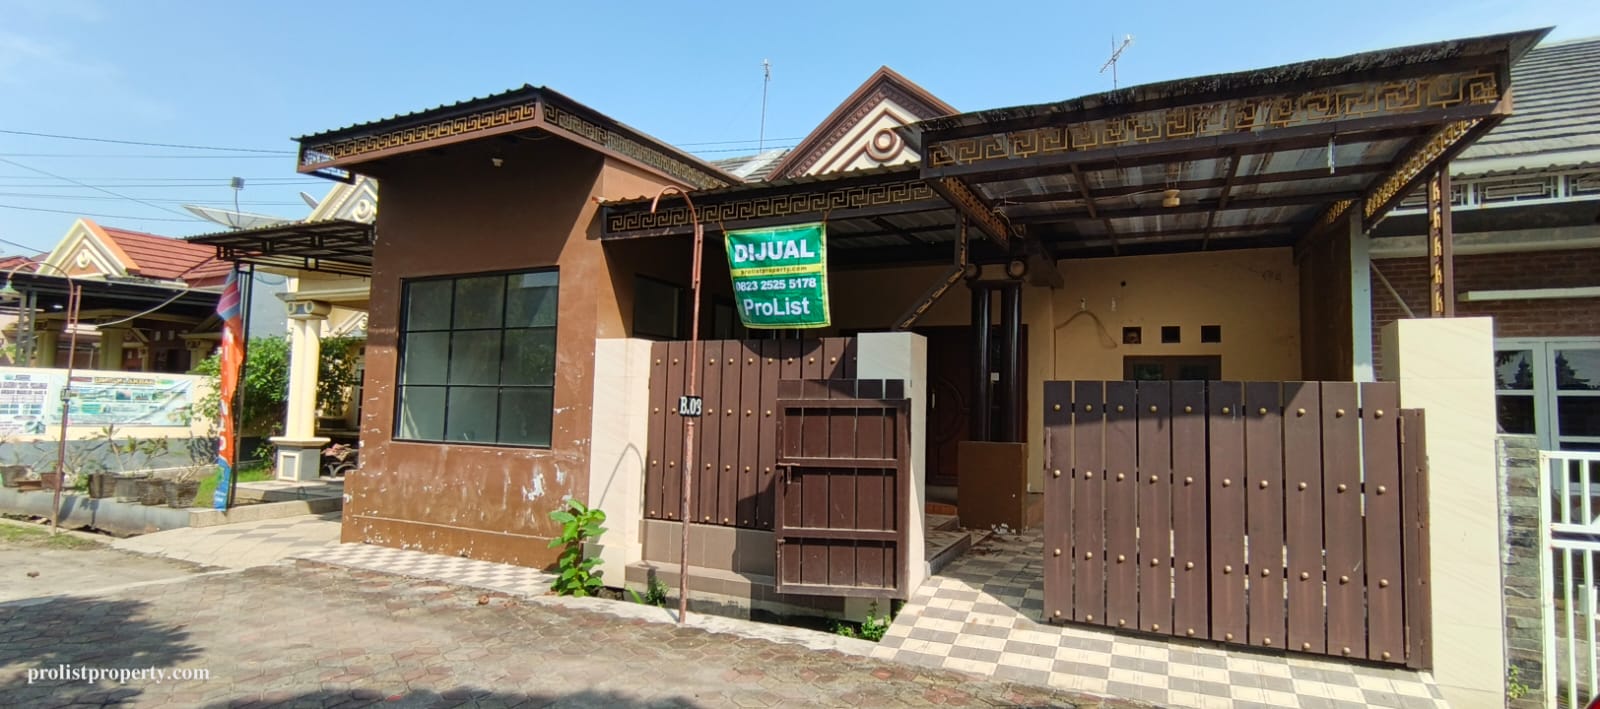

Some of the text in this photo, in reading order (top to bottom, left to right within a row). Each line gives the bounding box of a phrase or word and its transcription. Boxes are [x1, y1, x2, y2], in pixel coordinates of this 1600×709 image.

[734, 239, 815, 263] DIJUAL
[740, 266, 808, 276] prolistproperty.com
[735, 278, 816, 292] 0823 2525 5178
[743, 297, 811, 316] ProList
[680, 396, 702, 415] B.03
